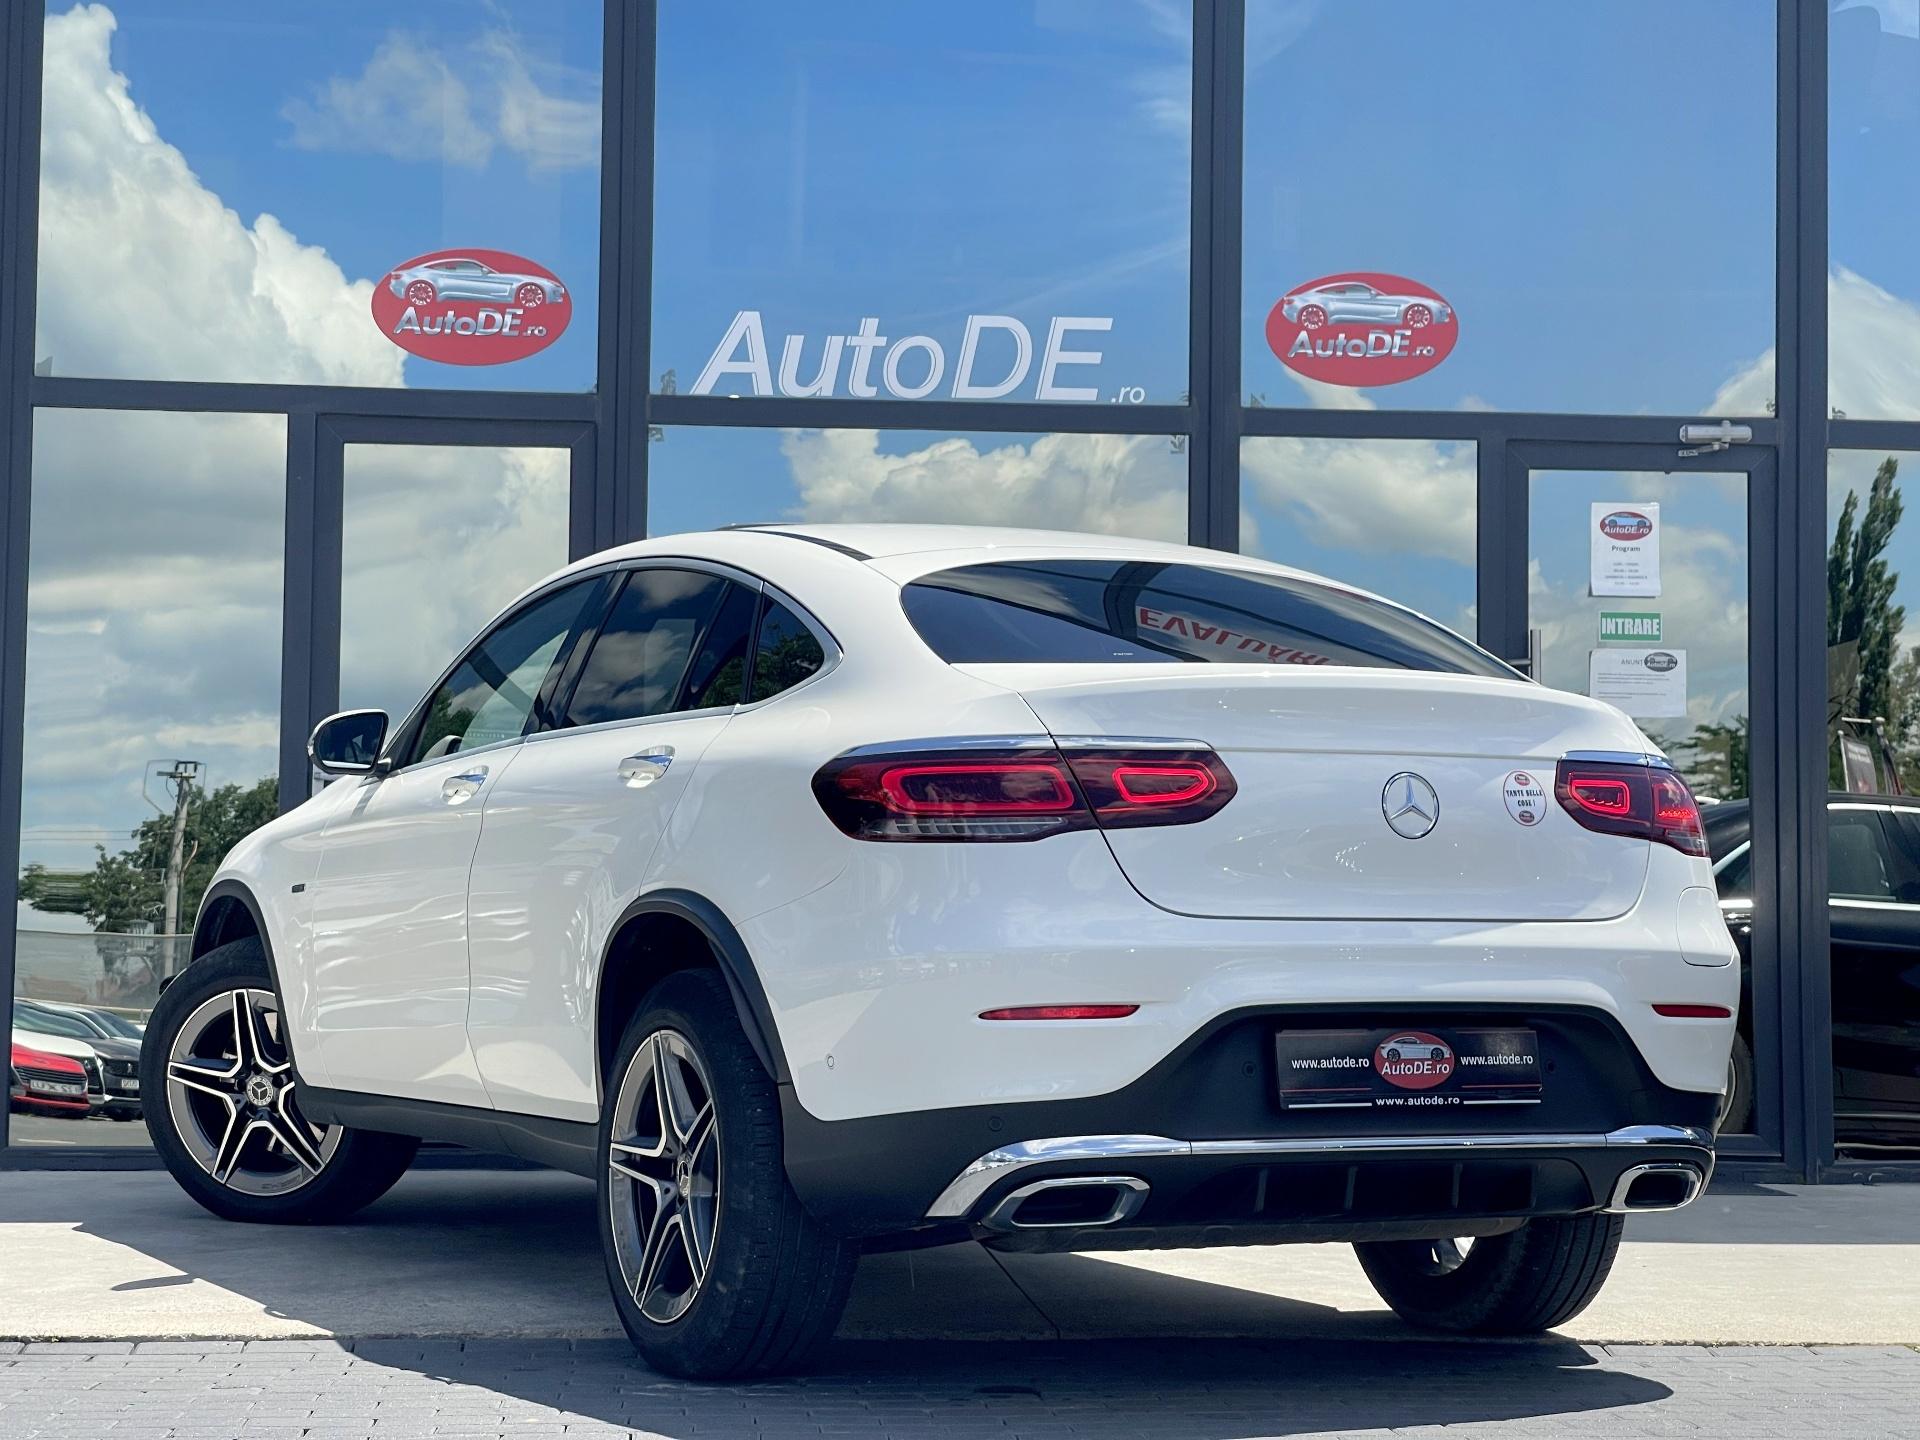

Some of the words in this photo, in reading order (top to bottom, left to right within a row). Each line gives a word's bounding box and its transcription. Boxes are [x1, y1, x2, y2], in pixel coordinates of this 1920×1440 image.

[1611, 545, 1641, 553] Program
[1601, 617, 1660, 636] INTRARE
[1505, 789, 1525, 797] TANTE
[1291, 1056, 1370, 1069] www.autode.ro
[1460, 1054, 1534, 1066] www.autode.ro
[1381, 1061, 1450, 1076] AutoDE.ro
[1375, 1096, 1460, 1106] www.autode.ro
